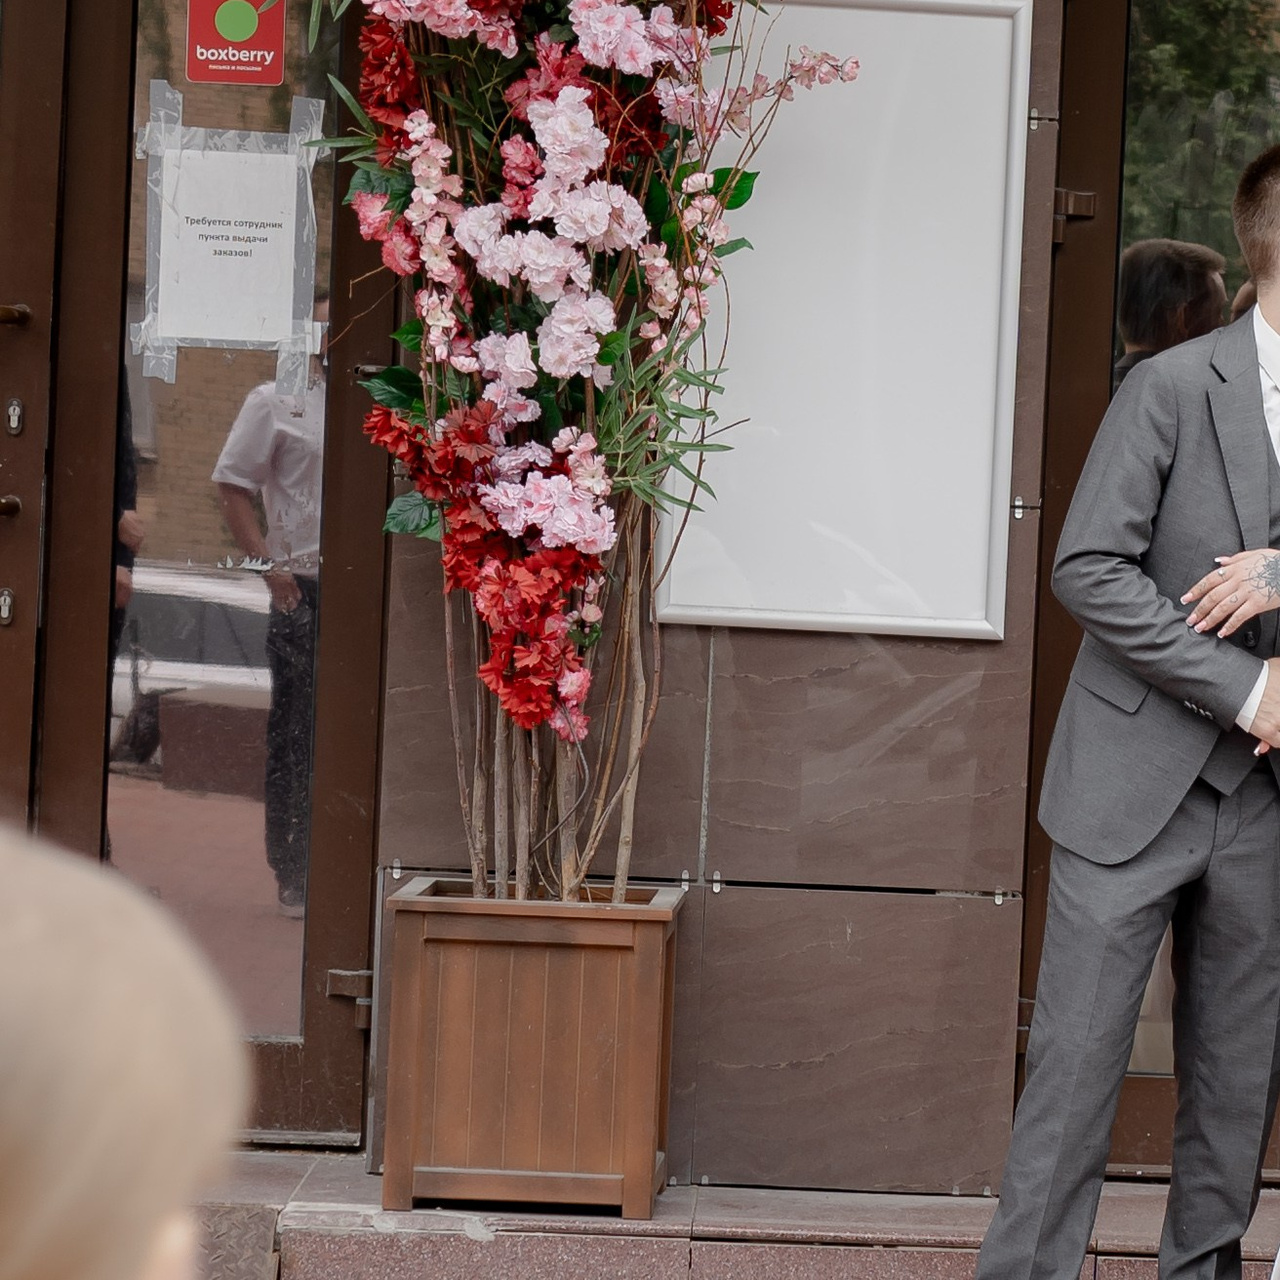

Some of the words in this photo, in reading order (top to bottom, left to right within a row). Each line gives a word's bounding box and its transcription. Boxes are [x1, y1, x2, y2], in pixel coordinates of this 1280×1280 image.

[196, 44, 274, 65] boxberry
[184, 216, 231, 227] Требуется
[233, 220, 283, 229] сотрудник
[198, 233, 230, 242] пункта
[232, 234, 268, 243] выдачи
[212, 249, 253, 258] заказов!
